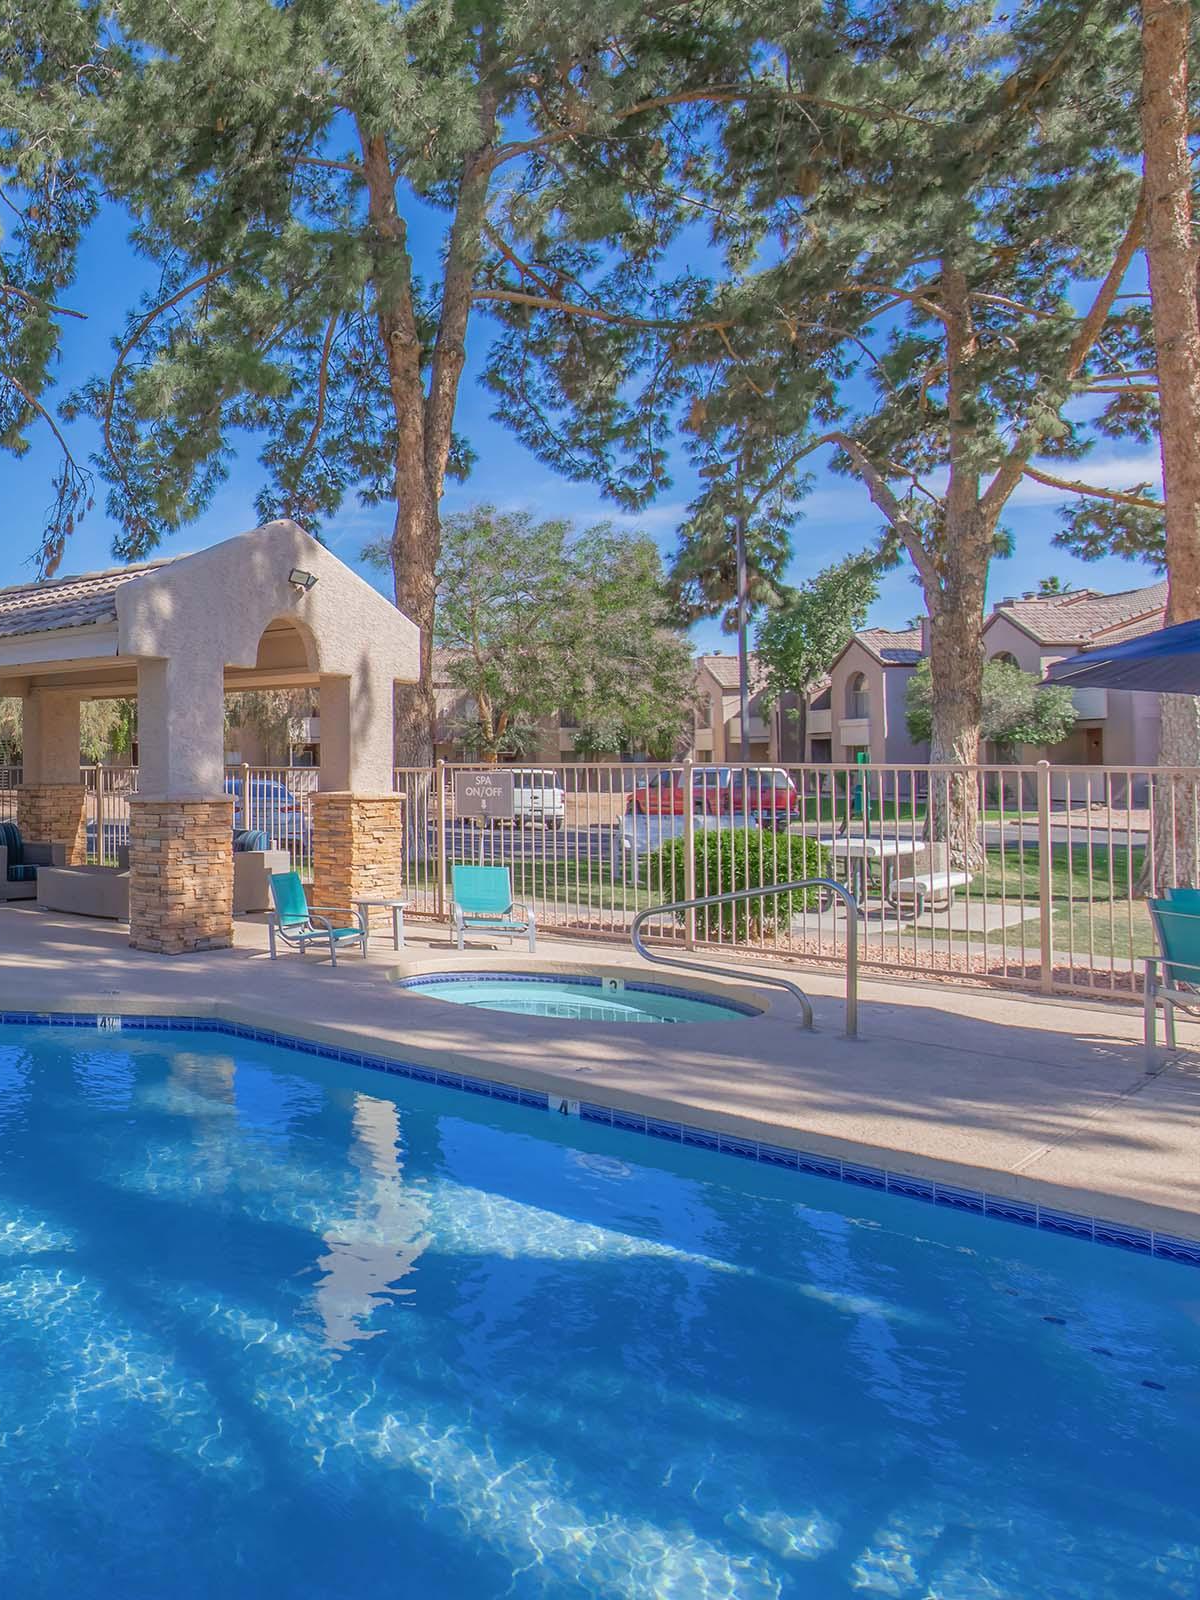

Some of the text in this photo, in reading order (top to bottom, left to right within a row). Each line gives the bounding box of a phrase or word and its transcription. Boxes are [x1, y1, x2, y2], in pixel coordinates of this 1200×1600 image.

[475, 775, 492, 786] SPA
[465, 786, 503, 798] ON/OFF
[558, 1099, 569, 1116] 4
